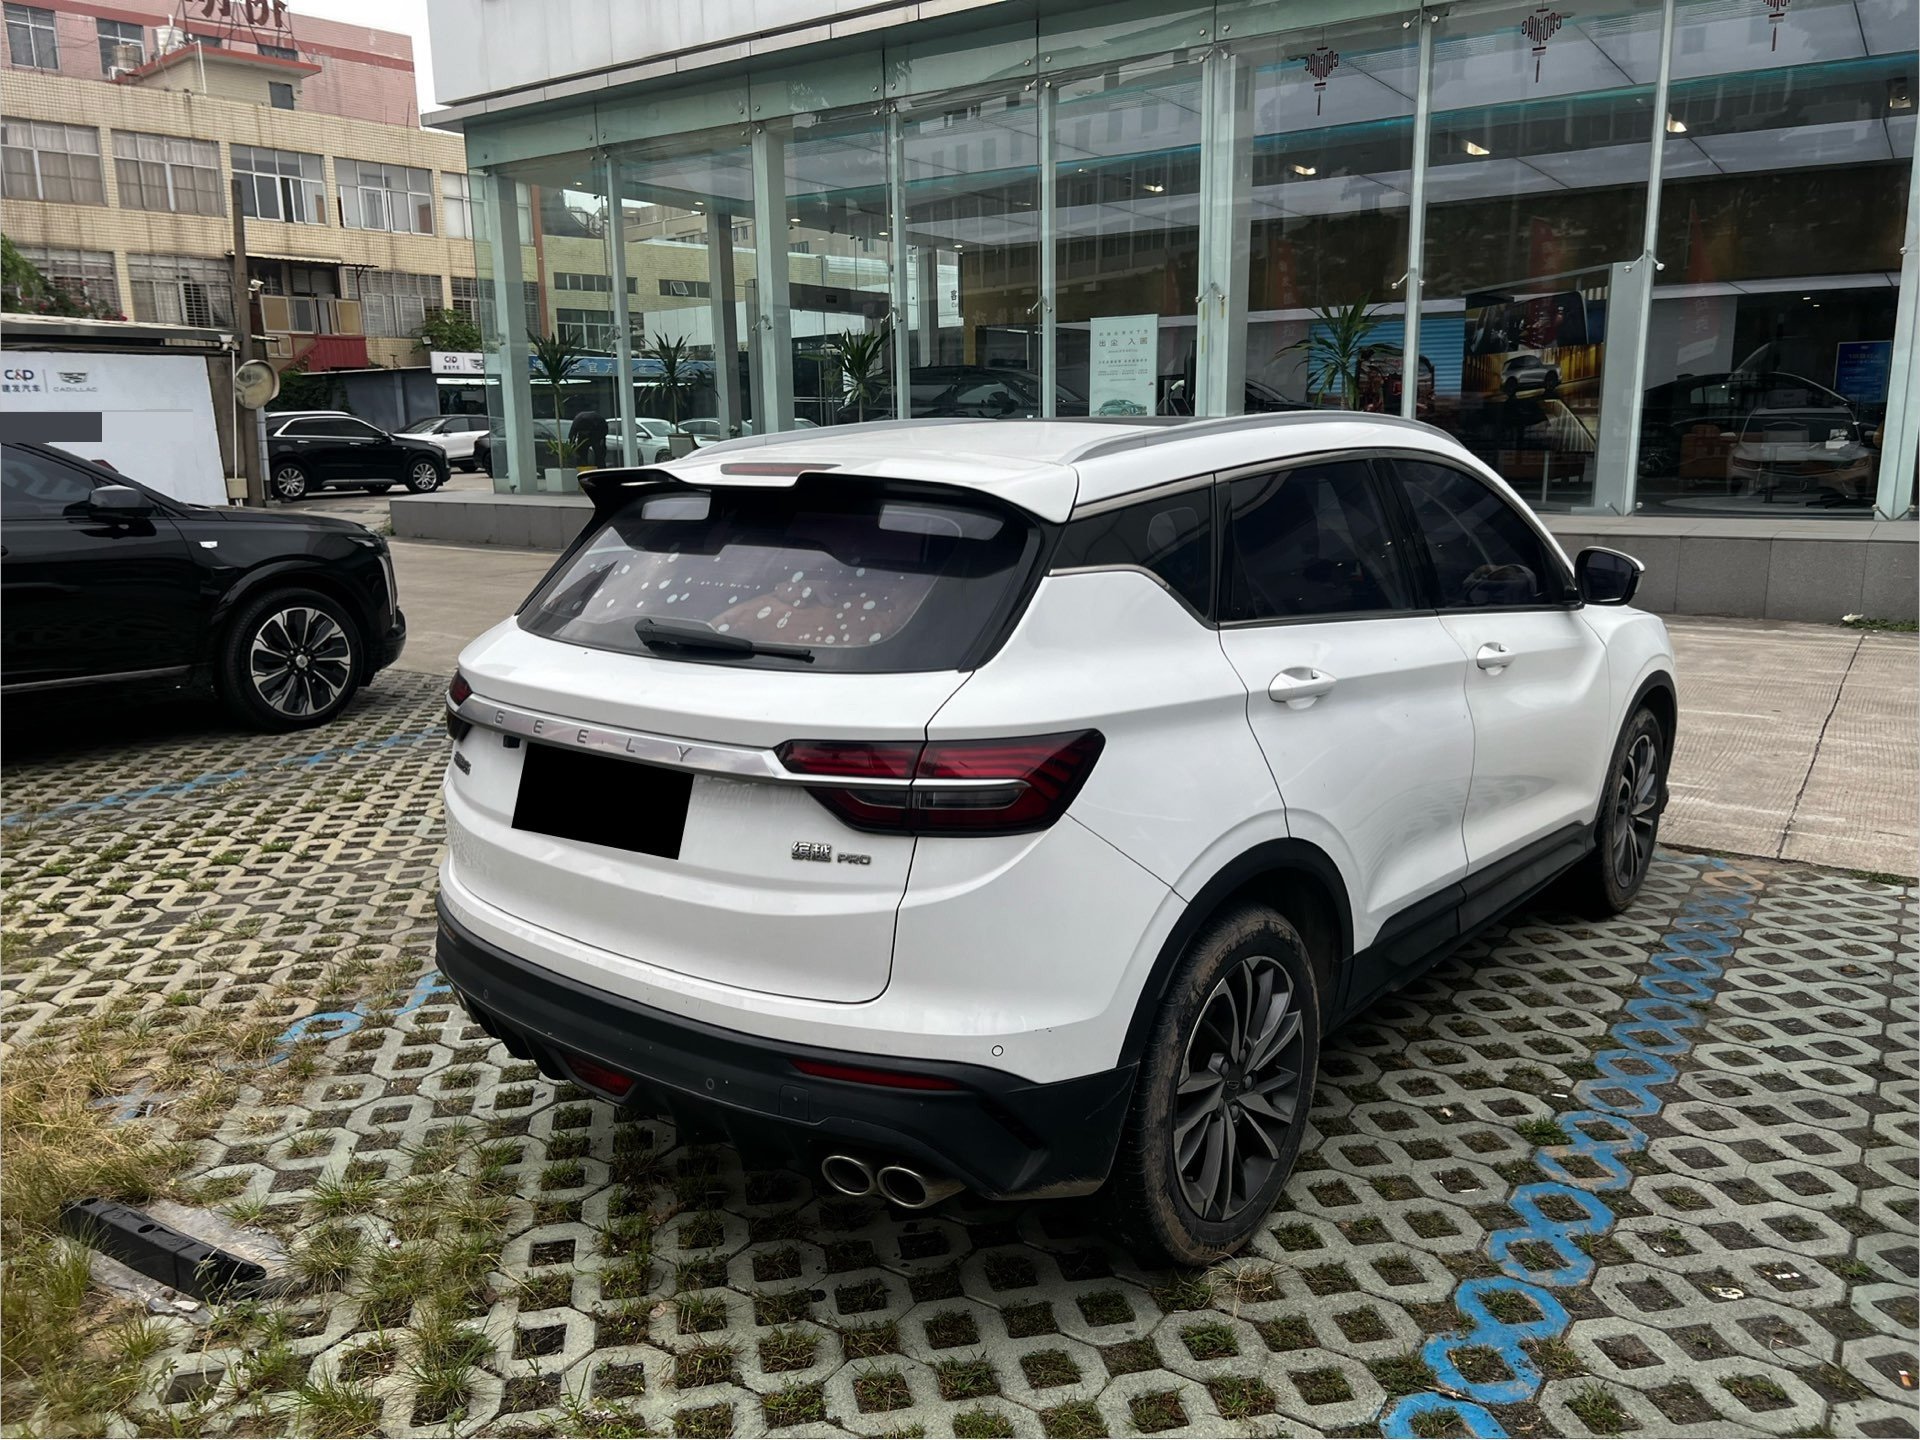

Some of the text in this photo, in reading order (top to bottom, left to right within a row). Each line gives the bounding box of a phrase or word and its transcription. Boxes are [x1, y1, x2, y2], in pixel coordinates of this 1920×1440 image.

[4, 368, 34, 381] C&D
[2, 384, 41, 393] 建发汽车
[494, 710, 693, 763] GEELY
[837, 853, 871, 865] PRO
